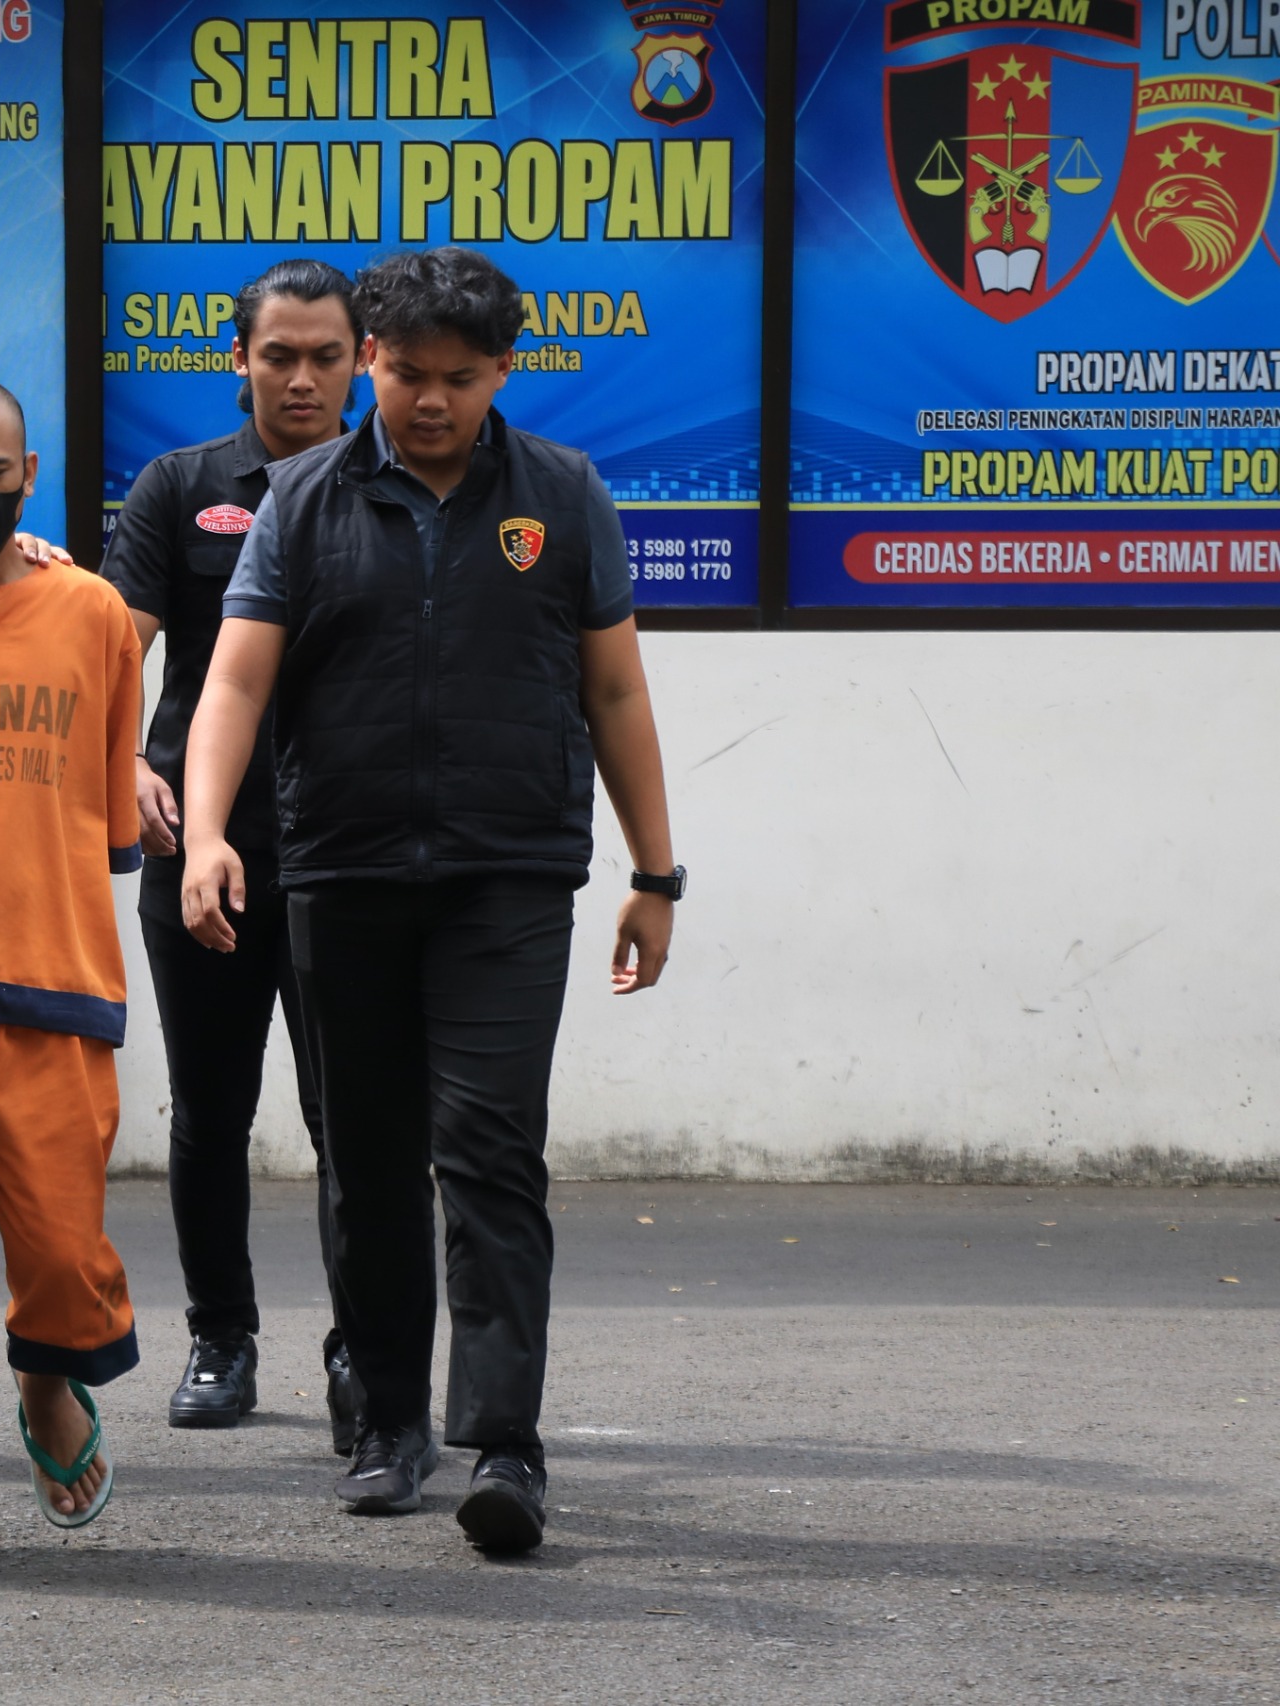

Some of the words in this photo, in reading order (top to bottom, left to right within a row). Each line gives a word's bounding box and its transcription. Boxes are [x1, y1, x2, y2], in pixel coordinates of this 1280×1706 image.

[642, 12, 672, 24] JAWA
[674, 12, 707, 23] TIMUR
[926, 0, 1090, 29] PROPAM
[190, 16, 497, 121] SENTRA
[1138, 83, 1251, 107] PAMINAL
[399, 138, 735, 244] PROPAM
[123, 292, 237, 339] SIAP
[518, 290, 650, 337] ANDA
[1035, 350, 1176, 393] PROPAM
[917, 409, 1004, 436] (DELEGASI
[1008, 408, 1126, 430] PENINGKATAN
[1131, 407, 1202, 430] DISIPLIN
[922, 449, 1097, 497] PROPAM
[1105, 448, 1214, 496] KUAT
[203, 520, 249, 531] HELSINKI
[644, 539, 686, 557] 5980
[690, 539, 732, 557] 1770
[874, 541, 973, 574] CERDAS
[980, 541, 1092, 574] BEKERJA
[1118, 541, 1223, 573] CERMAT
[643, 562, 686, 580] 5980
[690, 562, 732, 580] 1770
